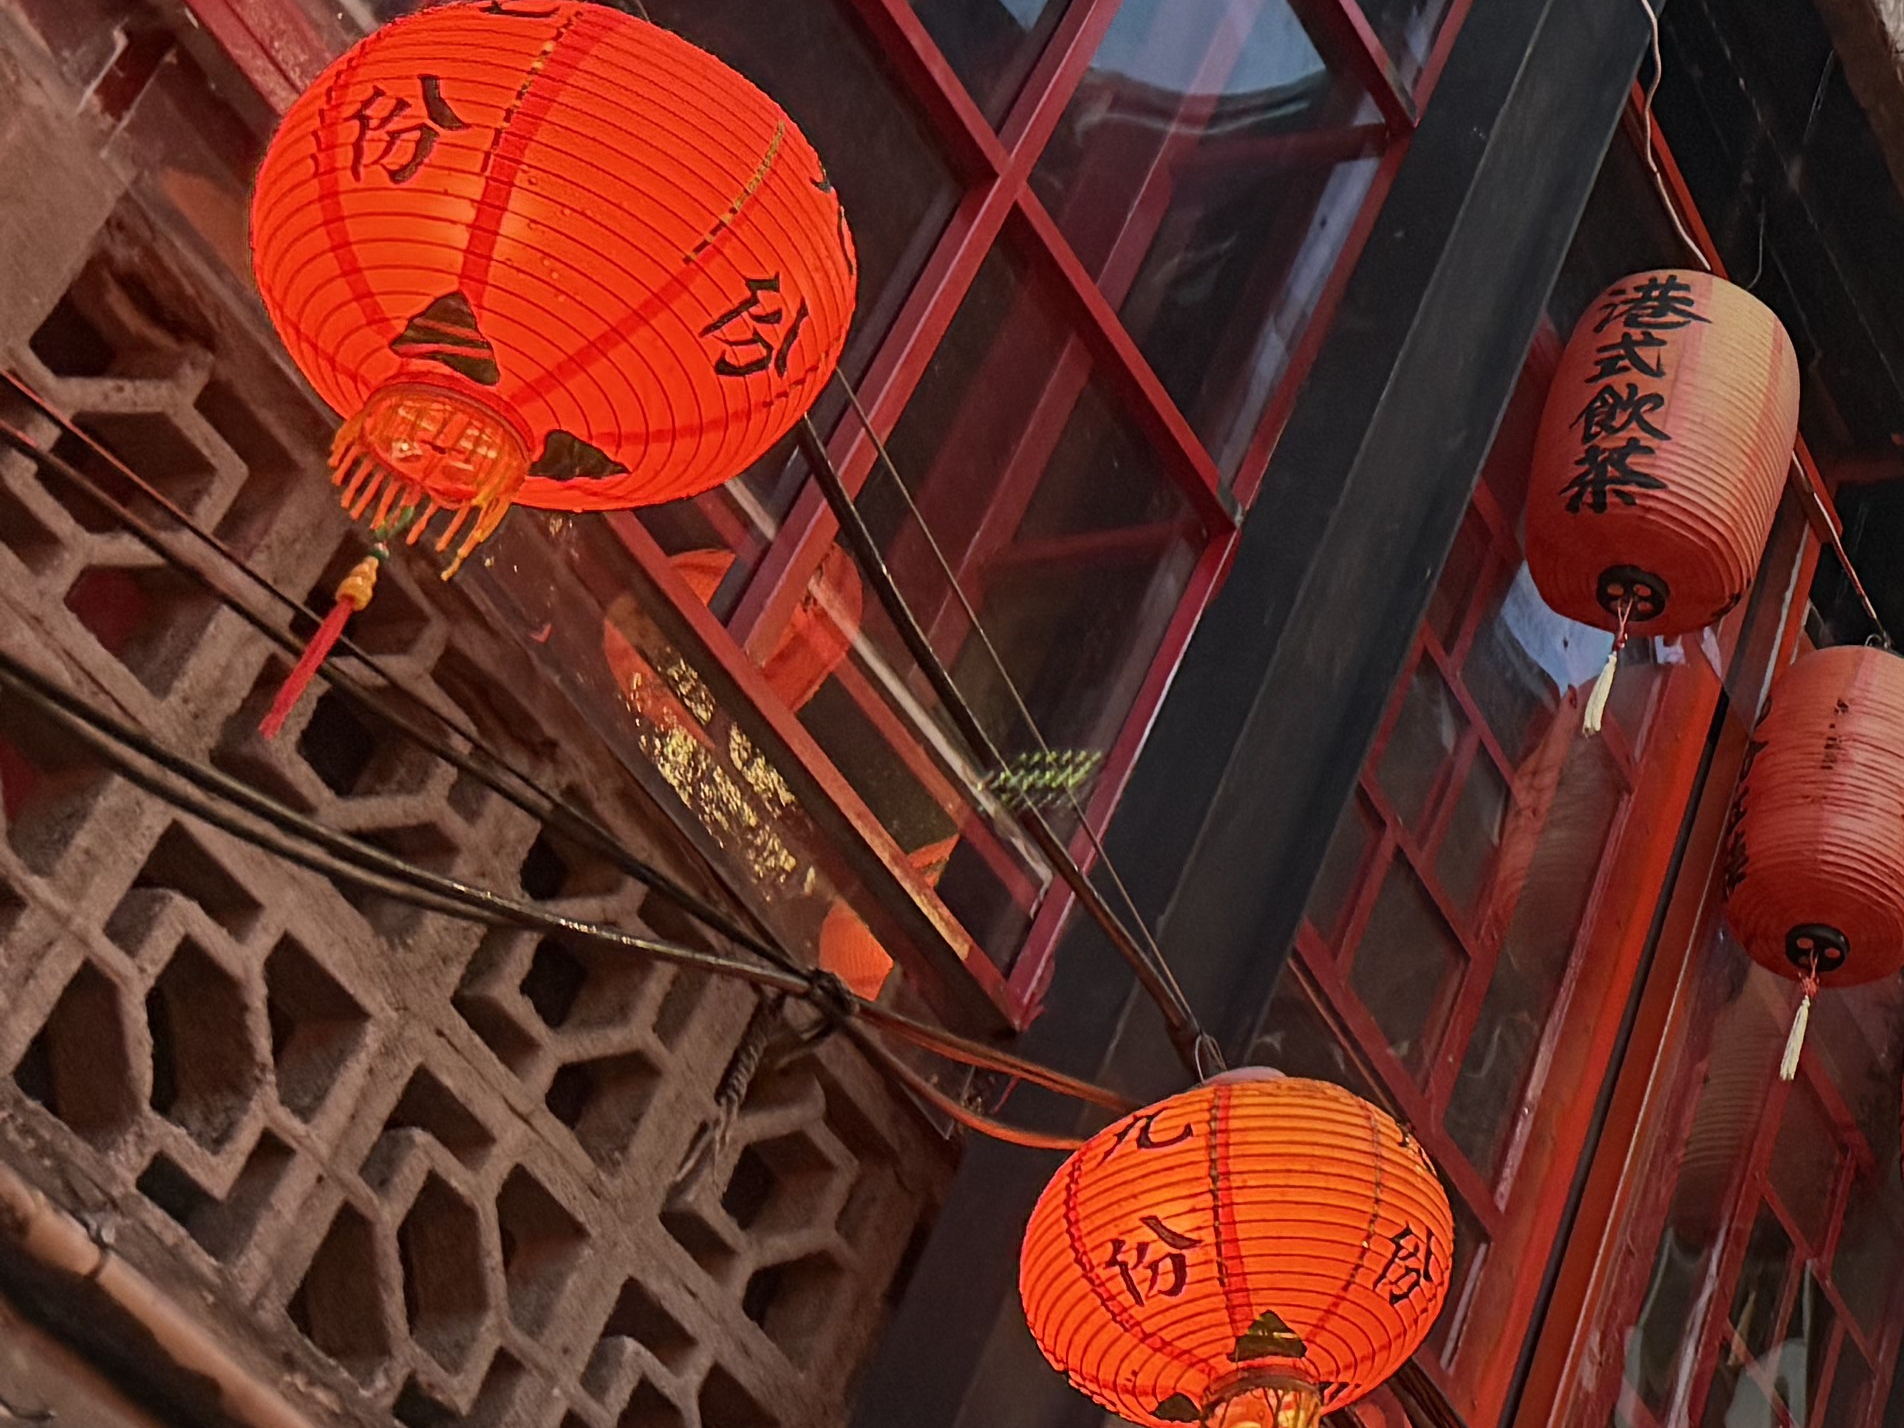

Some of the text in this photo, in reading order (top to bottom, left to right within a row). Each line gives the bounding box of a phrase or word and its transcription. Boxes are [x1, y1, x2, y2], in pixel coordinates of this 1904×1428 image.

[343, 74, 471, 185] 份
[1564, 275, 1712, 516] 港式飲茶
[1101, 1107, 1204, 1308] 九份
